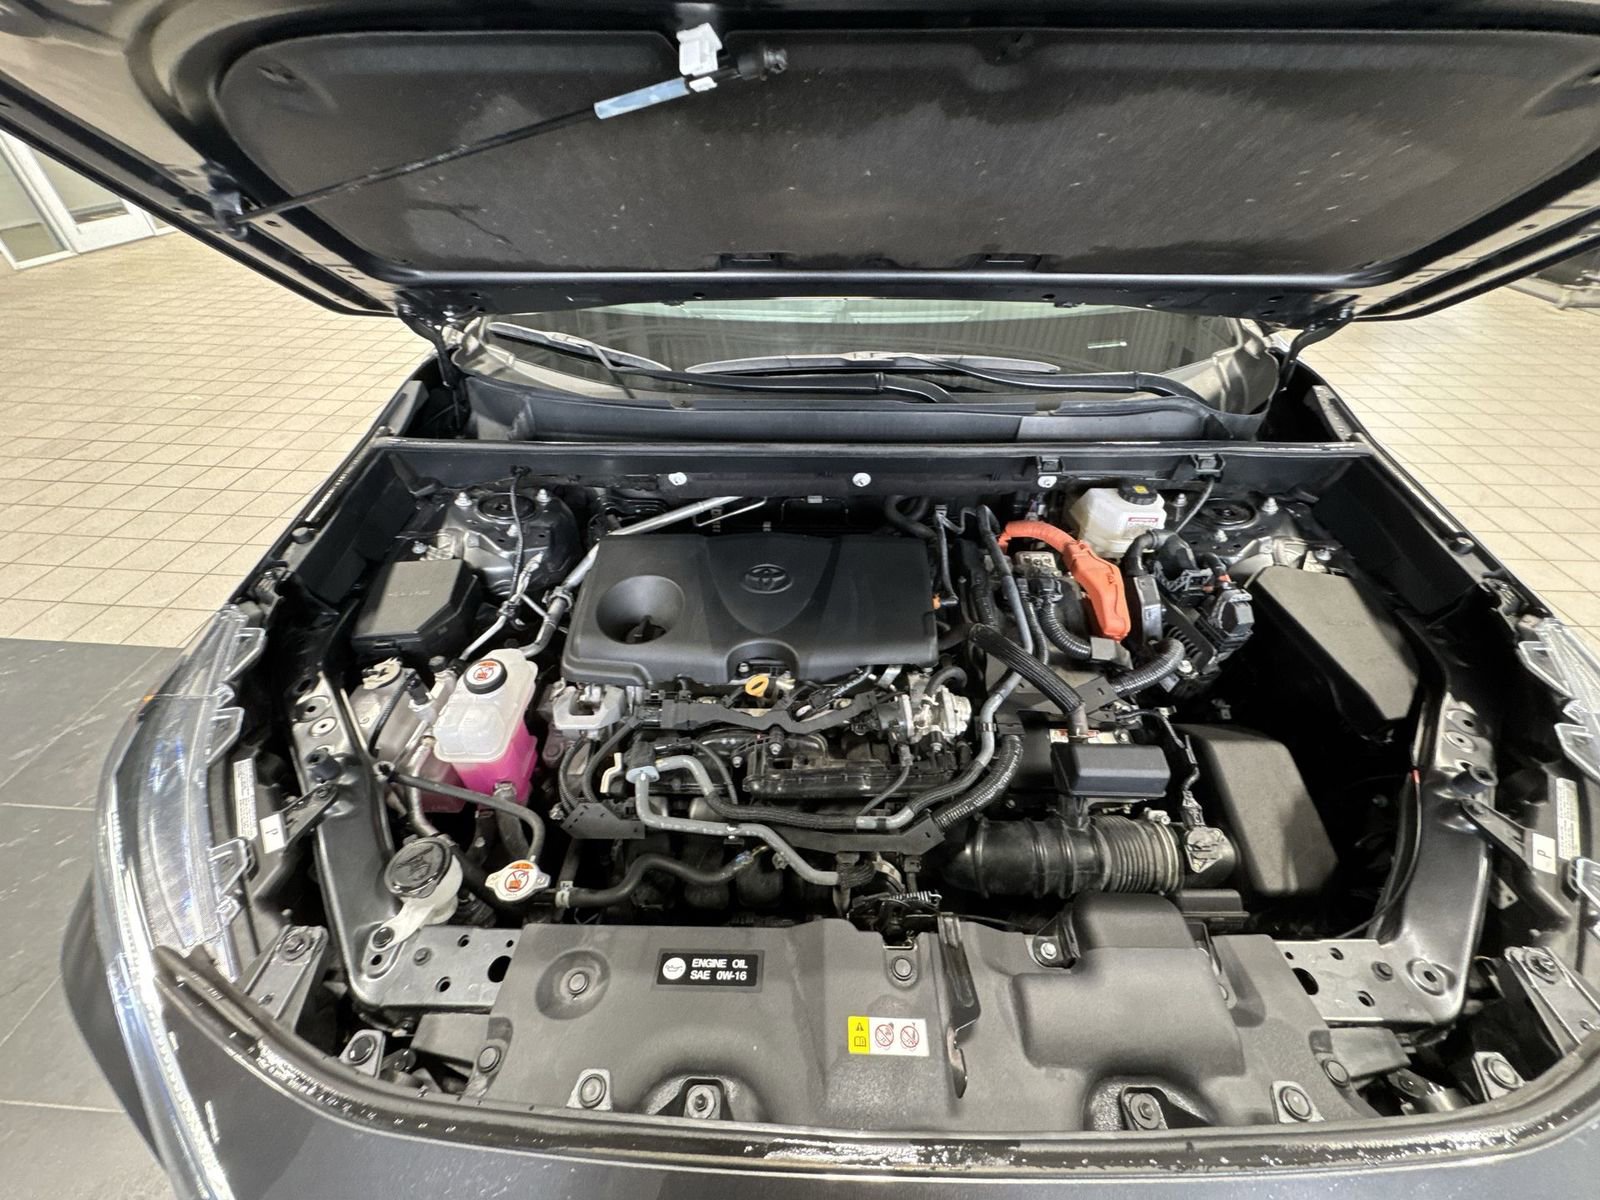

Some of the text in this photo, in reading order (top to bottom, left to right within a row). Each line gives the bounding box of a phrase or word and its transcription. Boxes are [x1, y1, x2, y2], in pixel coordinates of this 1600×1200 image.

[691, 958, 748, 969] ENGINE OIL
[690, 970, 747, 981] SAE 0W-16
